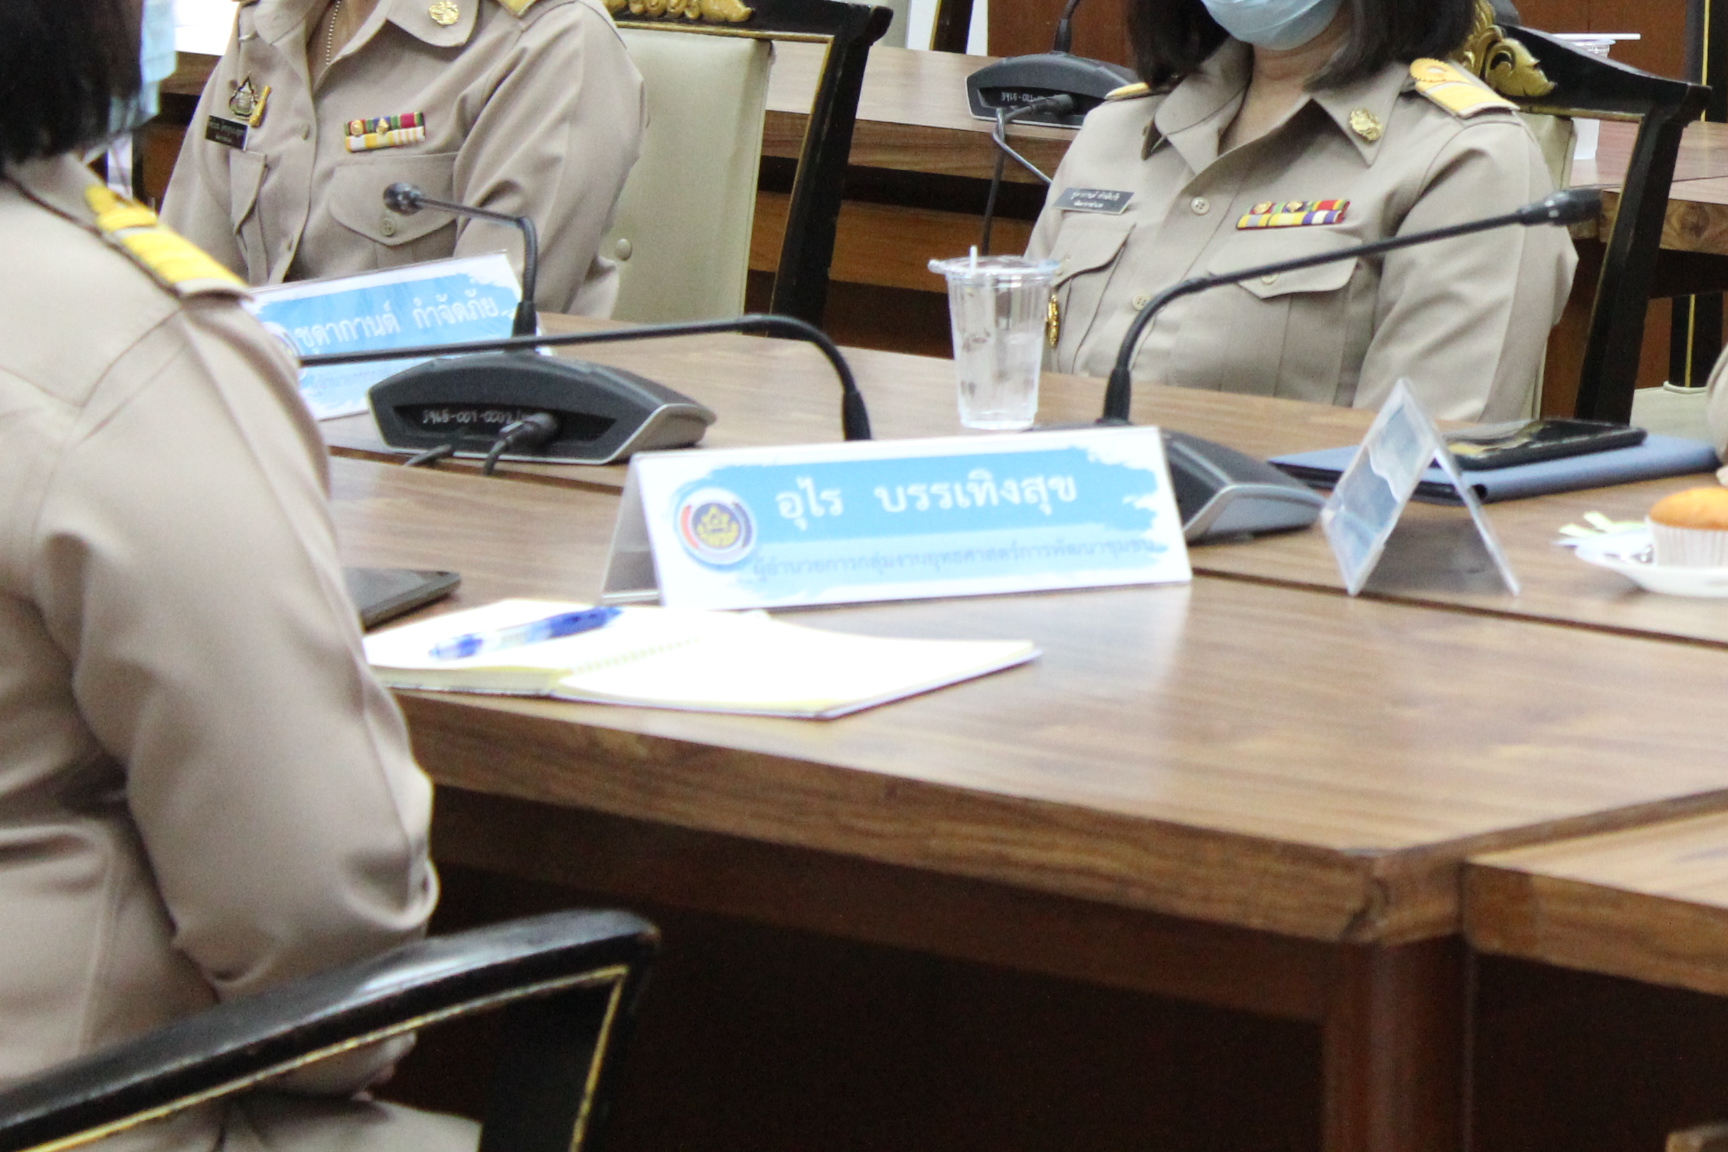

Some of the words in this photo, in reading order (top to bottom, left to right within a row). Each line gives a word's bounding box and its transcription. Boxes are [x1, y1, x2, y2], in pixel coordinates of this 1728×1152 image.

[774, 475, 844, 529] อุไร
[874, 465, 1079, 517] บรรเทิงสุข
